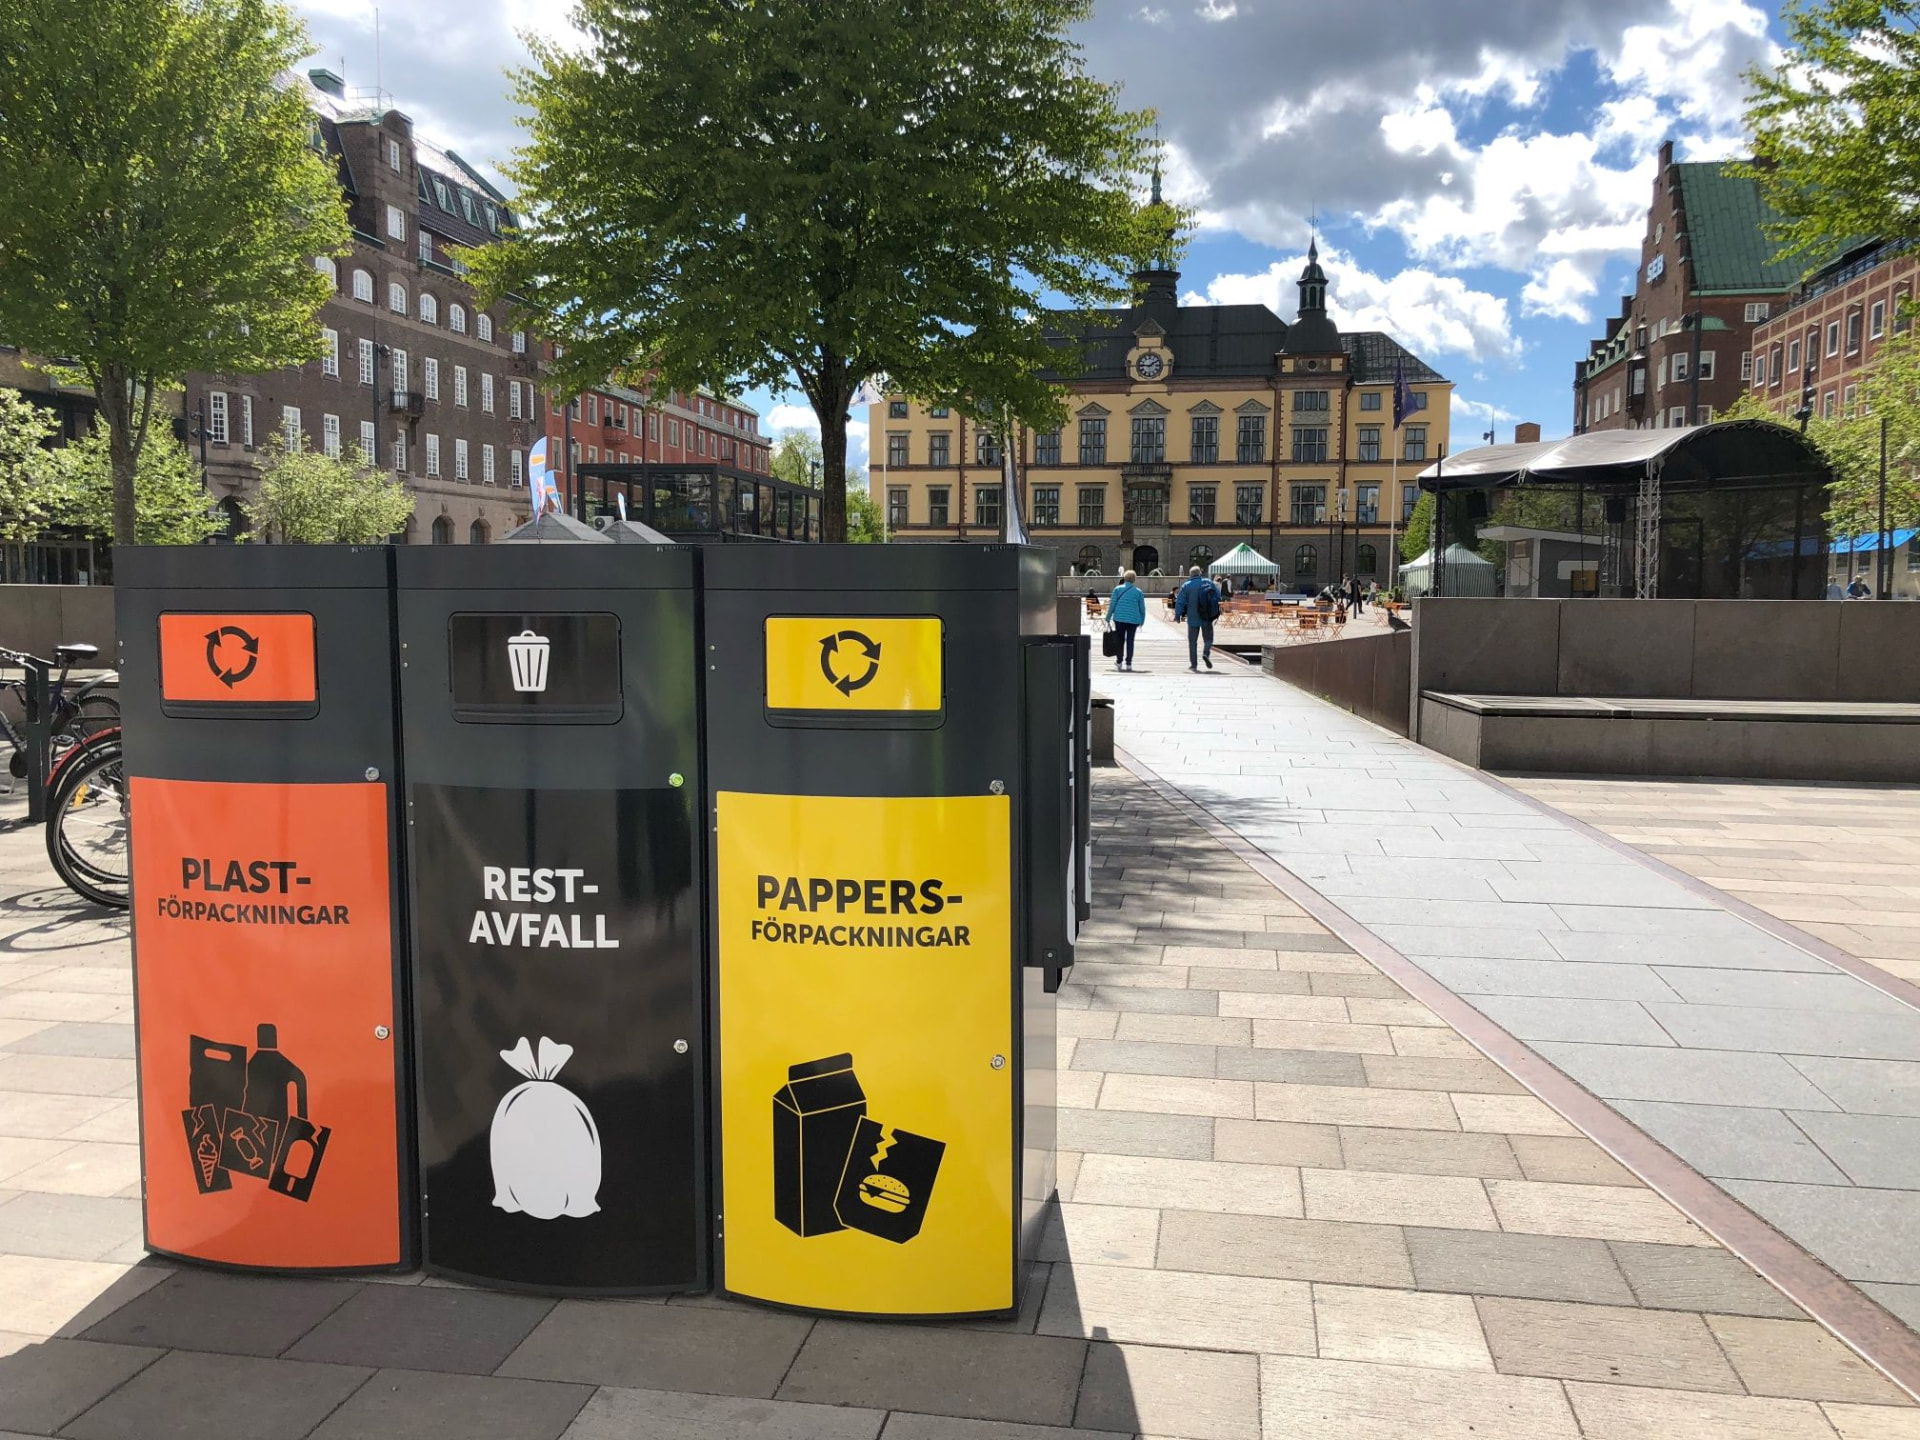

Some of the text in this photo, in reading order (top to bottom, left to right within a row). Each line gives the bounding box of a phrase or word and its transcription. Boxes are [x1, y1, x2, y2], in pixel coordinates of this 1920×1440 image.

[1646, 253, 1664, 283] SEB
[181, 857, 312, 894] PLAST-
[483, 865, 599, 903] REST-
[158, 894, 350, 925] FÖRPACKNINGAR
[757, 874, 963, 915] PAPPERS-
[468, 910, 620, 949] AVFALL
[751, 916, 971, 948] FÖRPACKNINGAR
